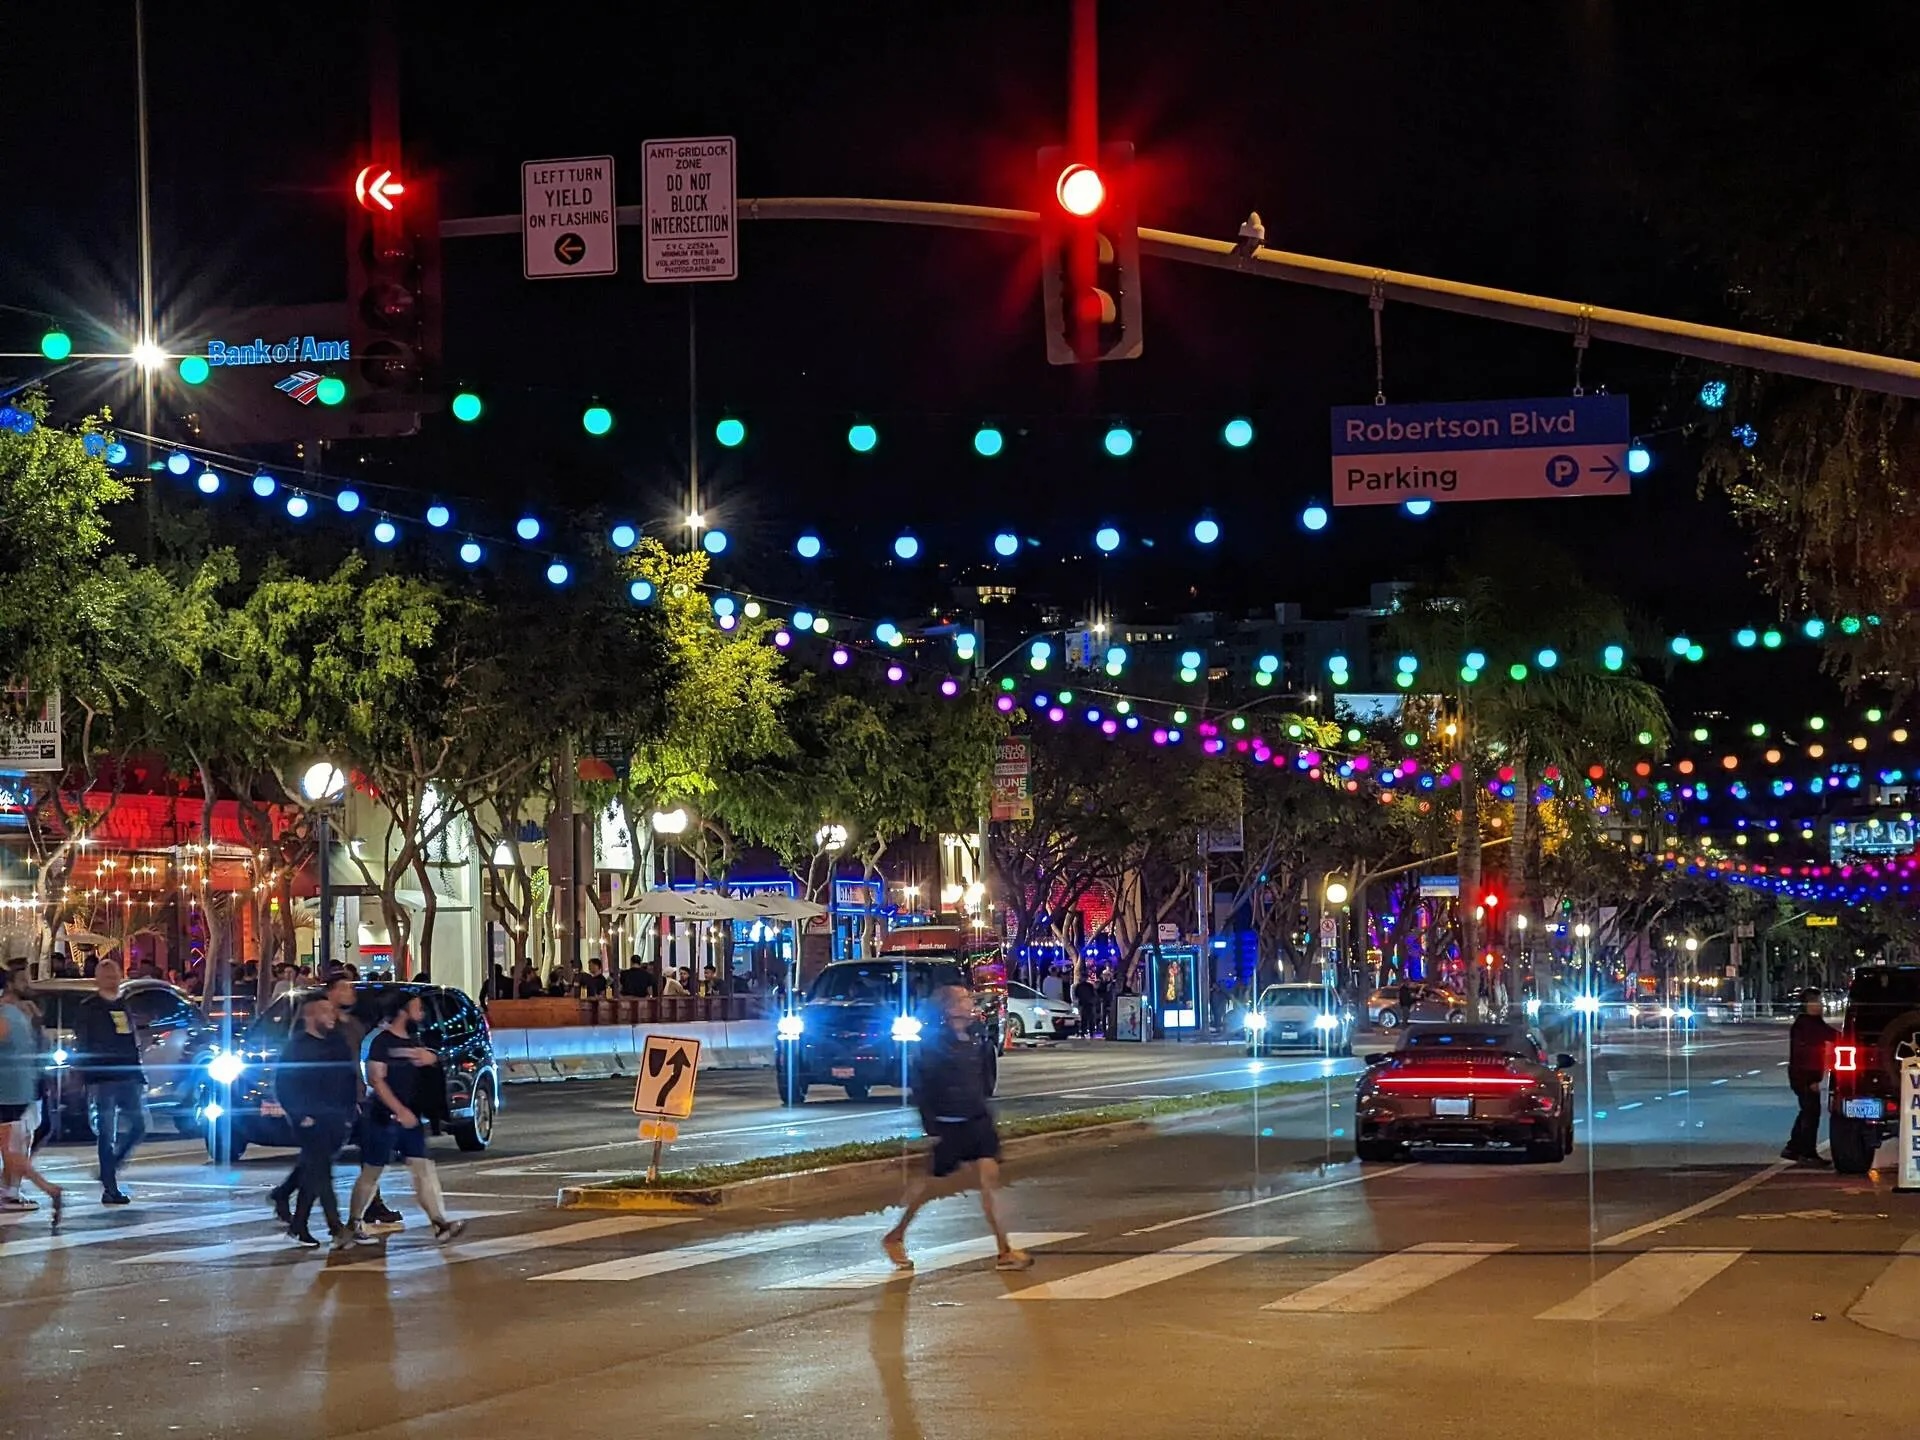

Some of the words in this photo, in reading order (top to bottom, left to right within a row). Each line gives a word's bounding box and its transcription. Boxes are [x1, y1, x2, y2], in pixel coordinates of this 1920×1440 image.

[650, 146, 728, 159] ANTI-GRIDLOCK
[675, 158, 702, 170] ZONE
[533, 170, 565, 185] LEFT
[568, 167, 602, 182] TURN
[667, 174, 682, 192] DO
[690, 173, 711, 191] NOT
[545, 187, 593, 208] YIELD
[671, 194, 708, 213] BLOCK
[529, 214, 546, 228] ON
[551, 210, 609, 226] FLASHING
[651, 214, 729, 235] INTERSECTION
[655, 259, 690, 267] VIOLATORS
[664, 265, 717, 273] PHOTOGRAPHED
[208, 338, 271, 366] Bank
[272, 337, 299, 362] of
[1346, 417, 1499, 442] Robertson
[1510, 410, 1576, 435] Blvd
[1347, 466, 1458, 491] Parking
[44, 721, 57, 733] ALL
[995, 752, 1026, 761] PRIDE
[996, 744, 1026, 754] WEHO
[996, 777, 1027, 788] JUNE
